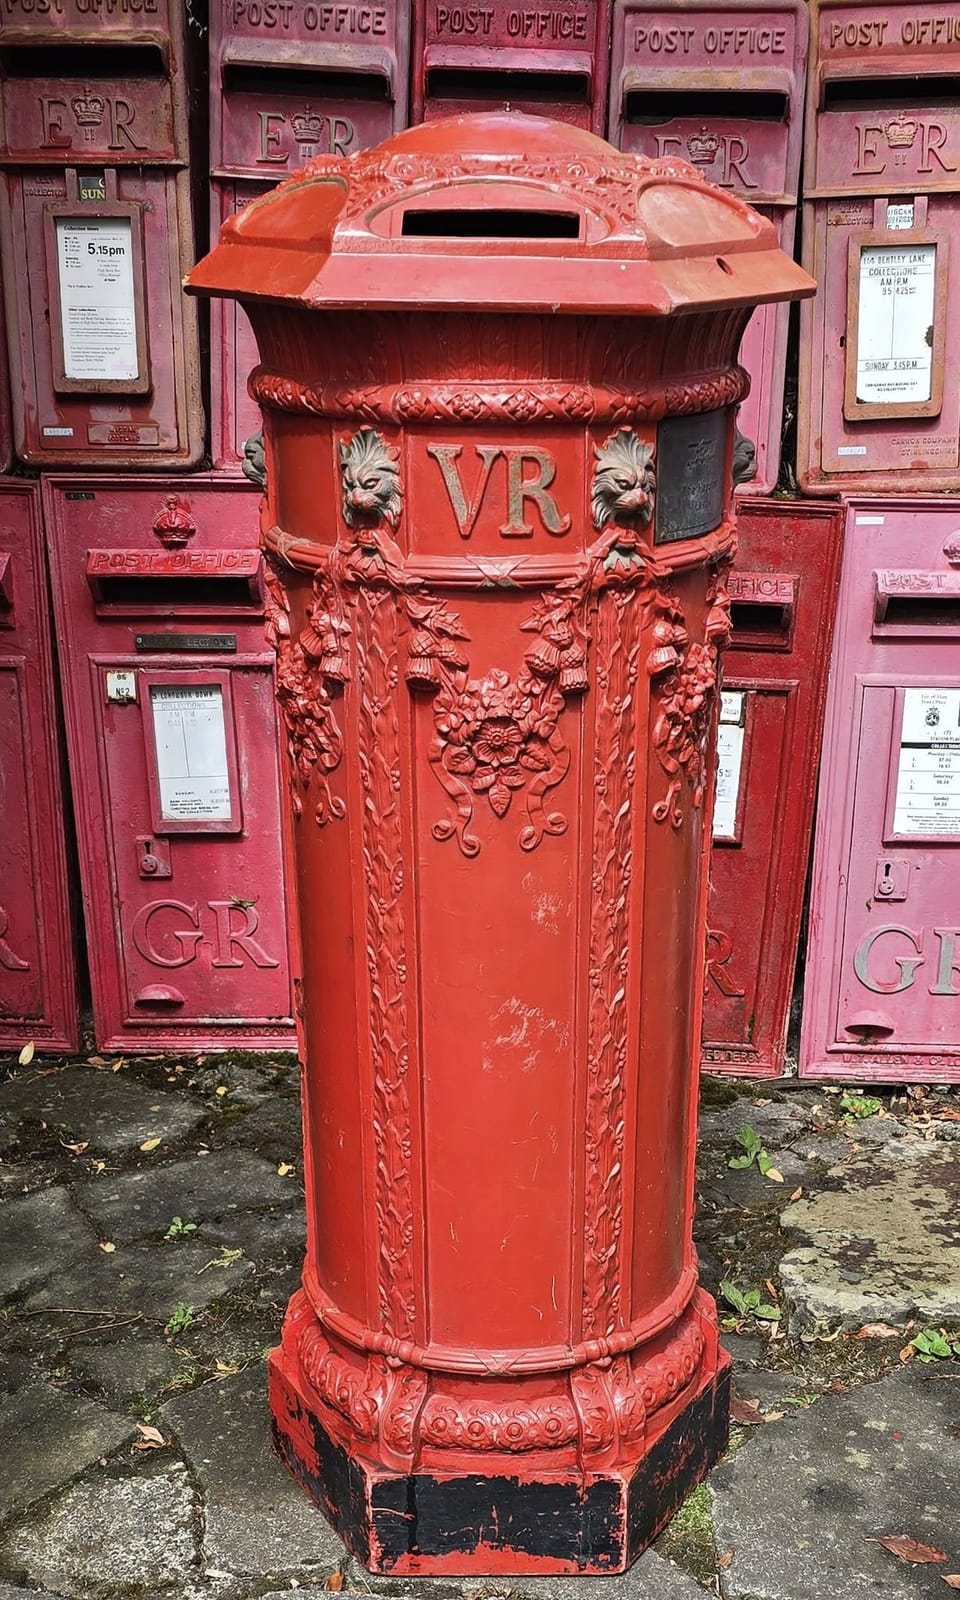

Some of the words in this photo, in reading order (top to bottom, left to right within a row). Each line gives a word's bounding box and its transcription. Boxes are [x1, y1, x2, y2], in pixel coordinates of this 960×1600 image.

[233, 2, 293, 29] POST
[303, 6, 387, 35] OFFICE
[436, 7, 494, 34] POST
[507, 10, 587, 40] OFFICE
[634, 27, 694, 54] POST
[703, 27, 786, 54] OFFICE
[830, 20, 888, 48] POST
[81, 188, 105, 200] SUN
[87, 242, 125, 257] 5.15pm
[878, 255, 906, 265] BENTLEY
[909, 254, 926, 264] LANE
[865, 361, 889, 371] SUNDAY
[426, 442, 572, 539] VR
[93, 552, 158, 569] POST
[170, 552, 254, 569] OFFICE
[132, 899, 280, 968] GR
